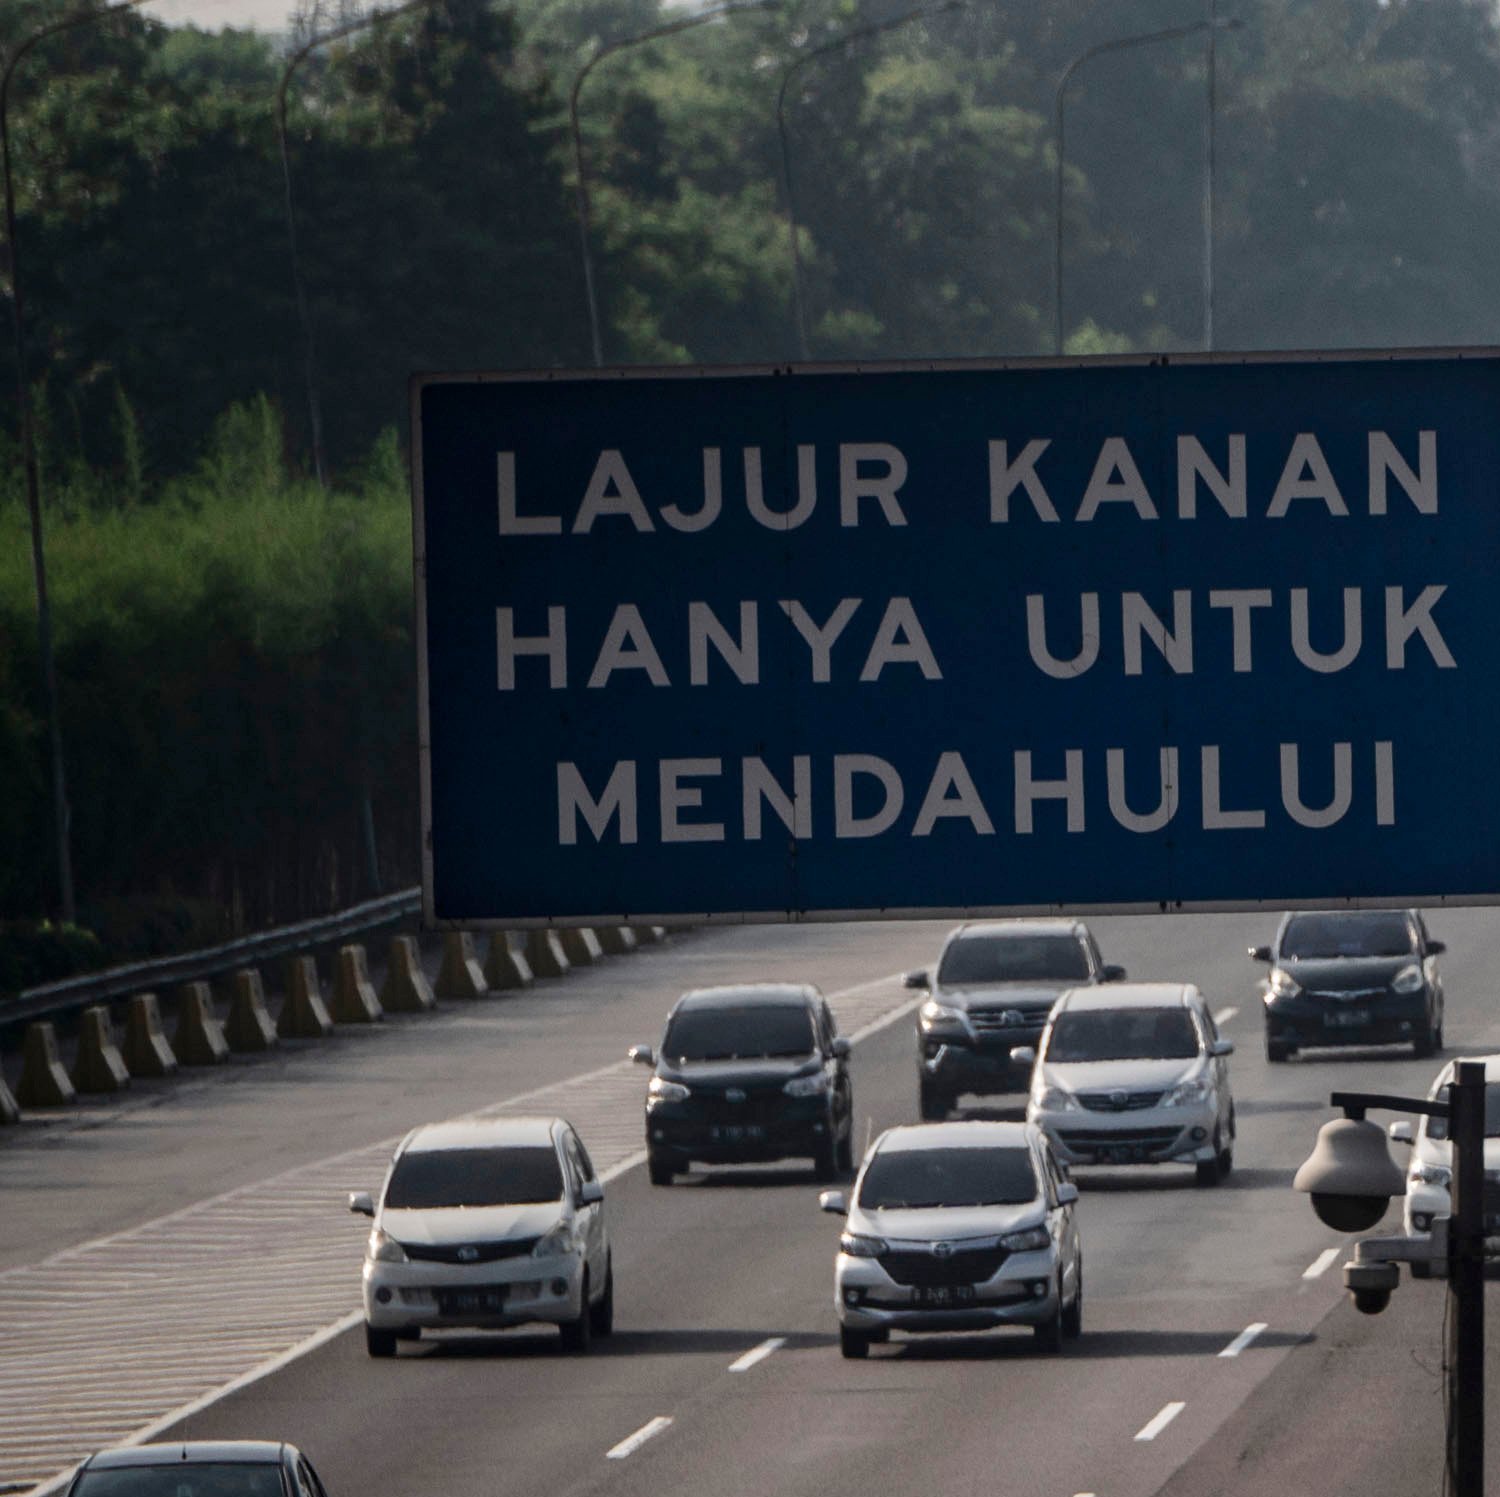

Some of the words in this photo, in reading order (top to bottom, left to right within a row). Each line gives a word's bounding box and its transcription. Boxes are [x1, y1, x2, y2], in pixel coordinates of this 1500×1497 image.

[497, 442, 908, 535] LAJUR
[989, 430, 1439, 523] KANAN
[495, 597, 942, 689] HANYA
[1026, 584, 1457, 679] UNTUK
[557, 741, 1396, 844] MENDAHULUI
